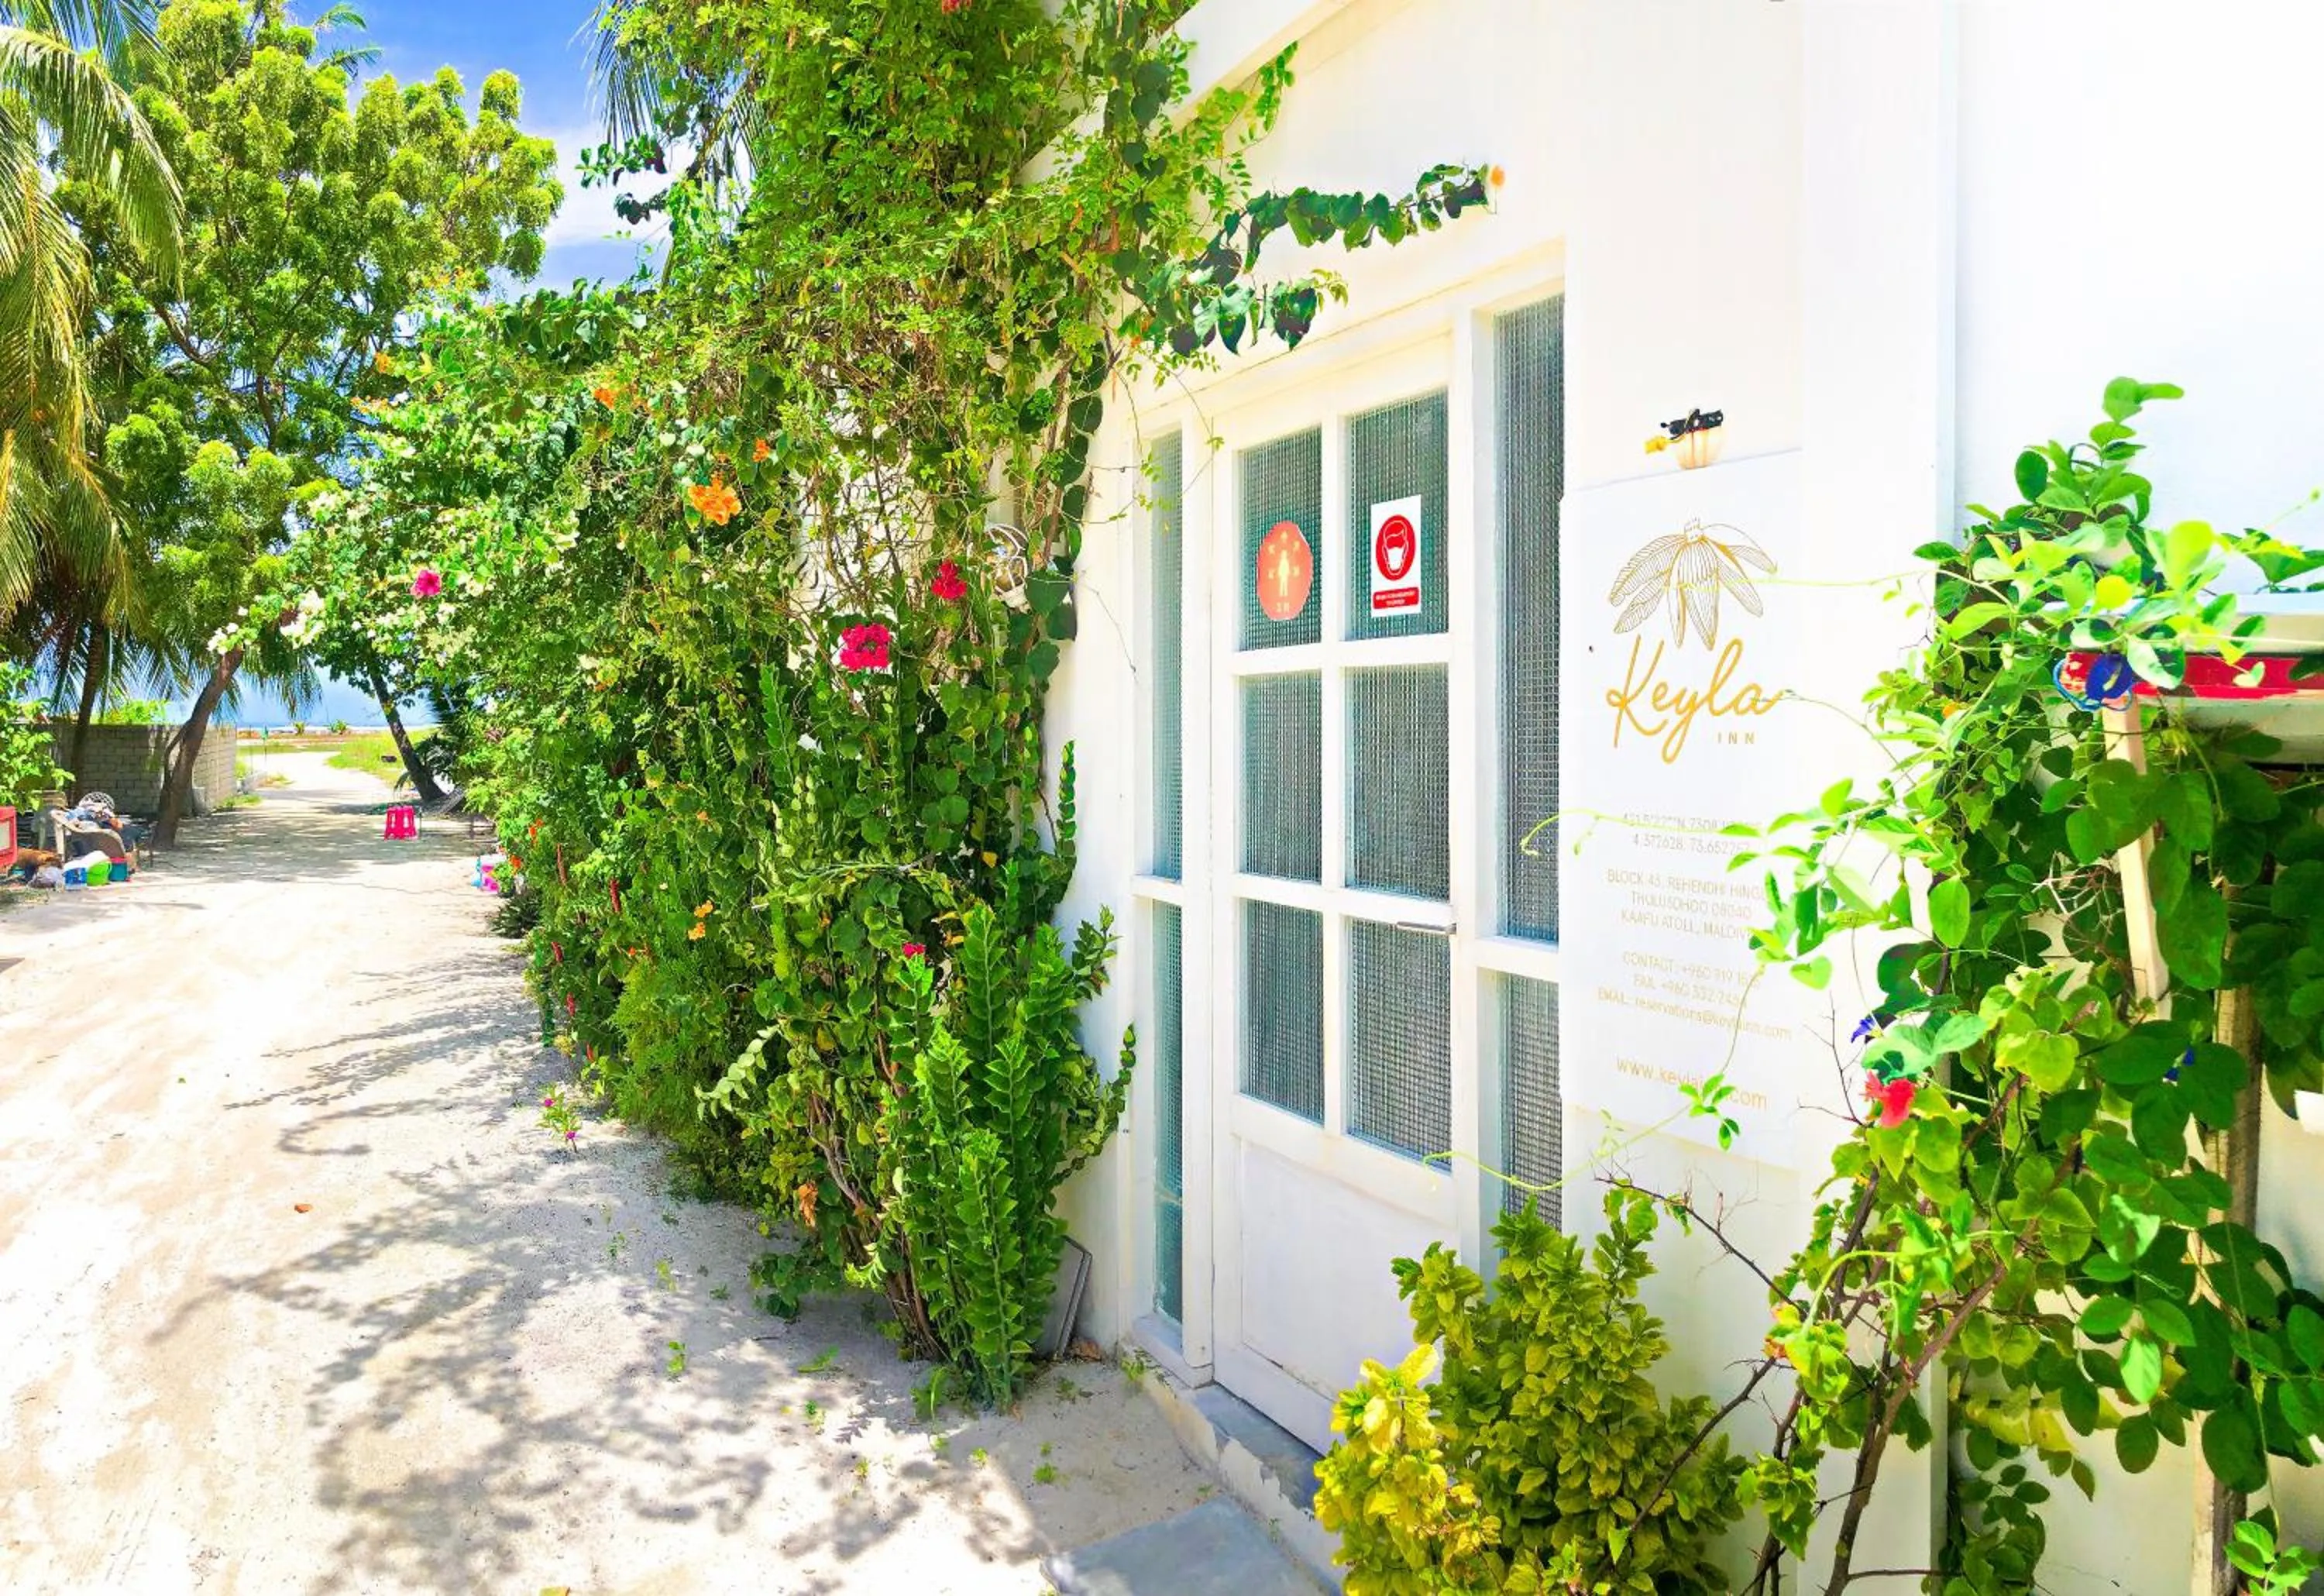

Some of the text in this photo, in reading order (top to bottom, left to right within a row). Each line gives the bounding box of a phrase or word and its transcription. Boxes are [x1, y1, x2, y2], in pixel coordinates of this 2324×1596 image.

[1606, 635, 1783, 764] Keyla
[1717, 732, 1755, 744] INN
[1607, 869, 1642, 885] BLOCK
[1621, 910, 1658, 927] KAAFU
